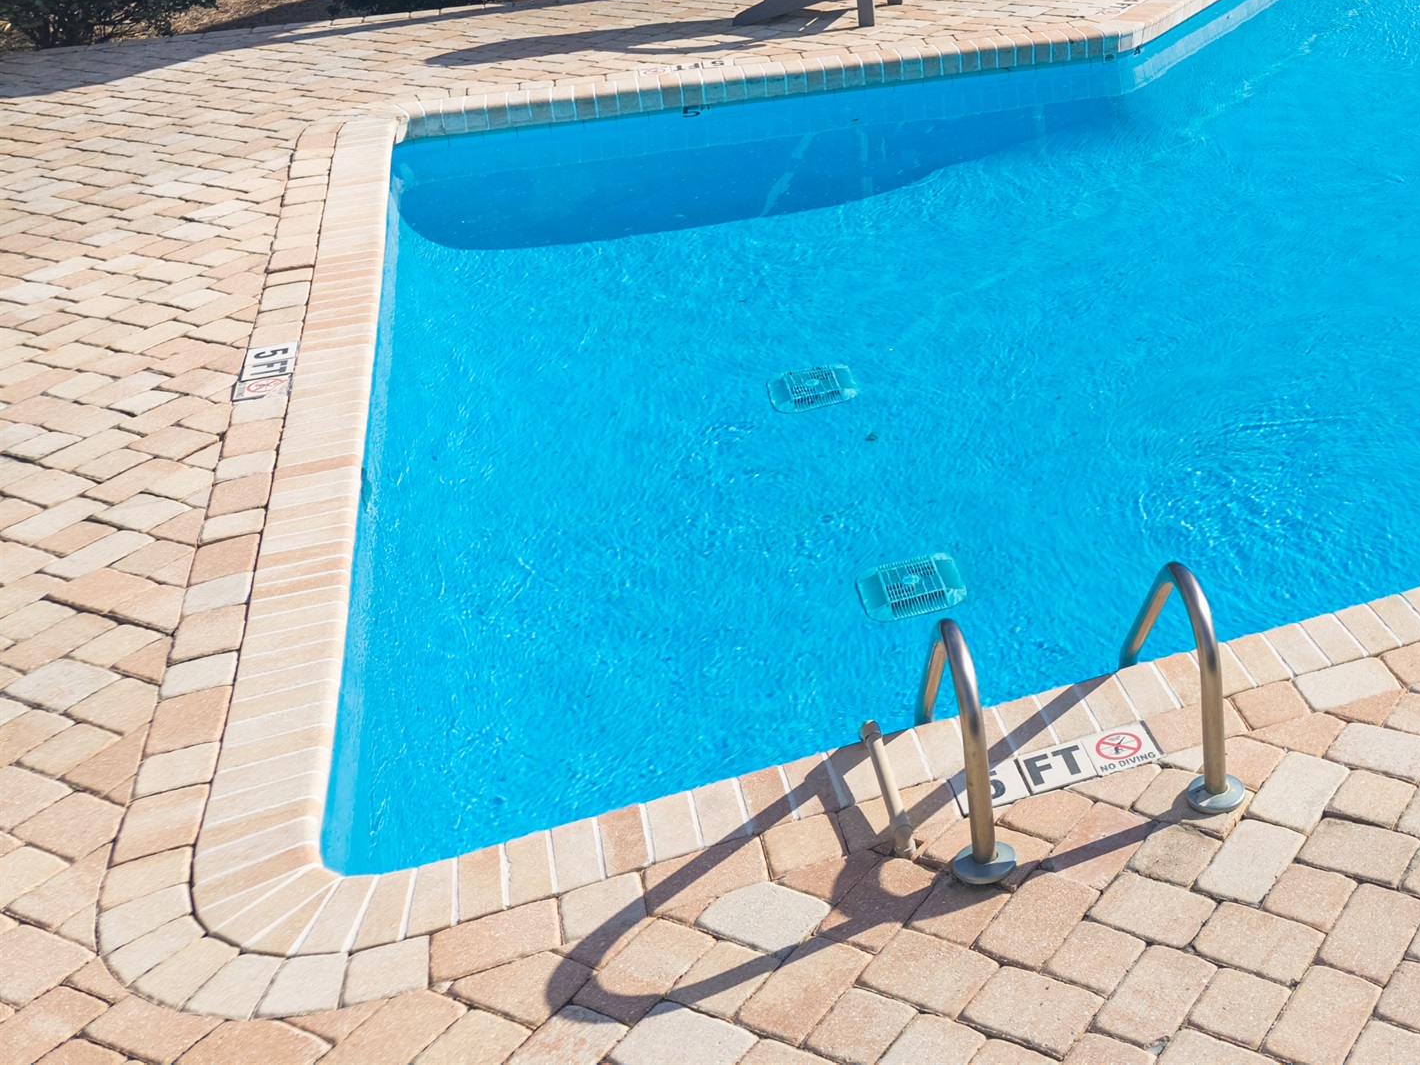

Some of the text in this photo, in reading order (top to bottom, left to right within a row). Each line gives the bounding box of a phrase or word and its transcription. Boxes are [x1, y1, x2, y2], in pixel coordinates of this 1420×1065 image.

[250, 347, 289, 376] 5 FT
[1022, 744, 1082, 786] FT
[1100, 751, 1156, 772] NO DIVING
